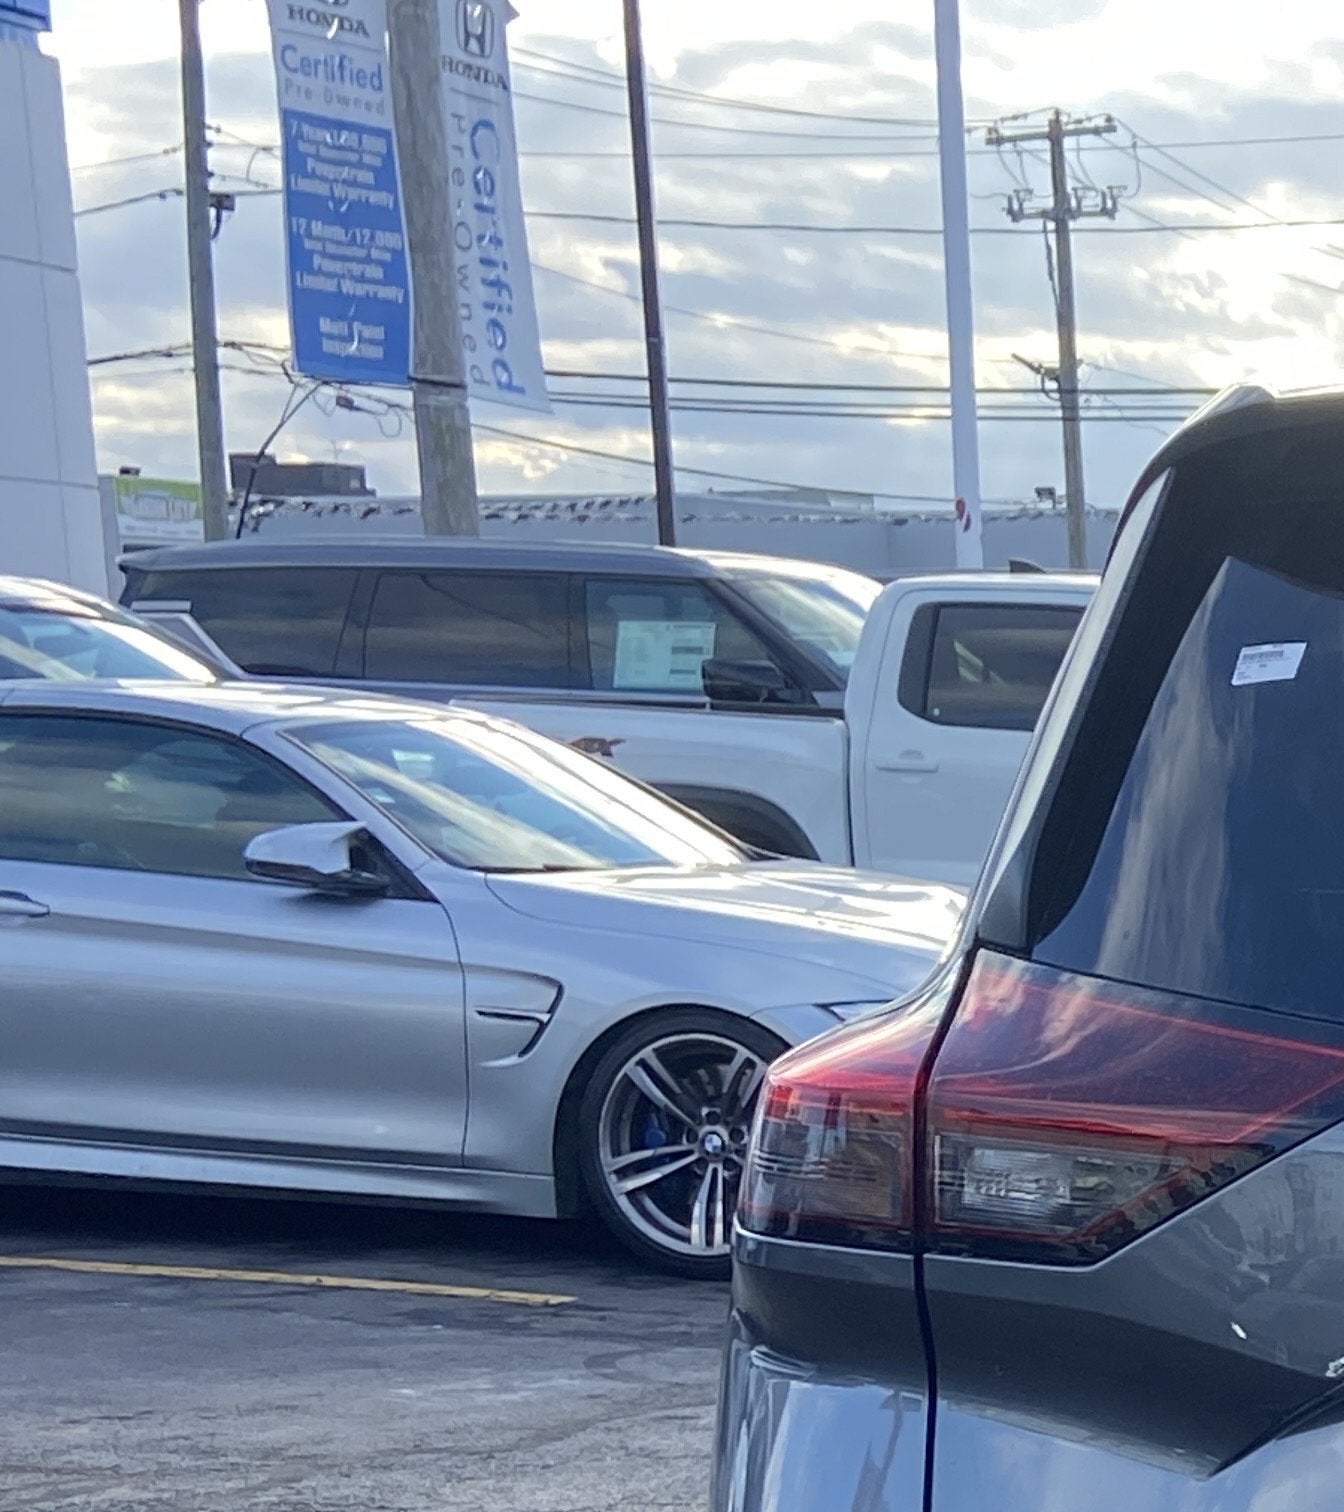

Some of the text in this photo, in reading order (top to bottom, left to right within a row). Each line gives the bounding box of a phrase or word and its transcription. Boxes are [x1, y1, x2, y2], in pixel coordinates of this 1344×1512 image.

[286, 3, 370, 38] HONDA
[280, 43, 384, 92] Certified
[441, 54, 509, 92] HONDA
[470, 118, 526, 395] Certified
